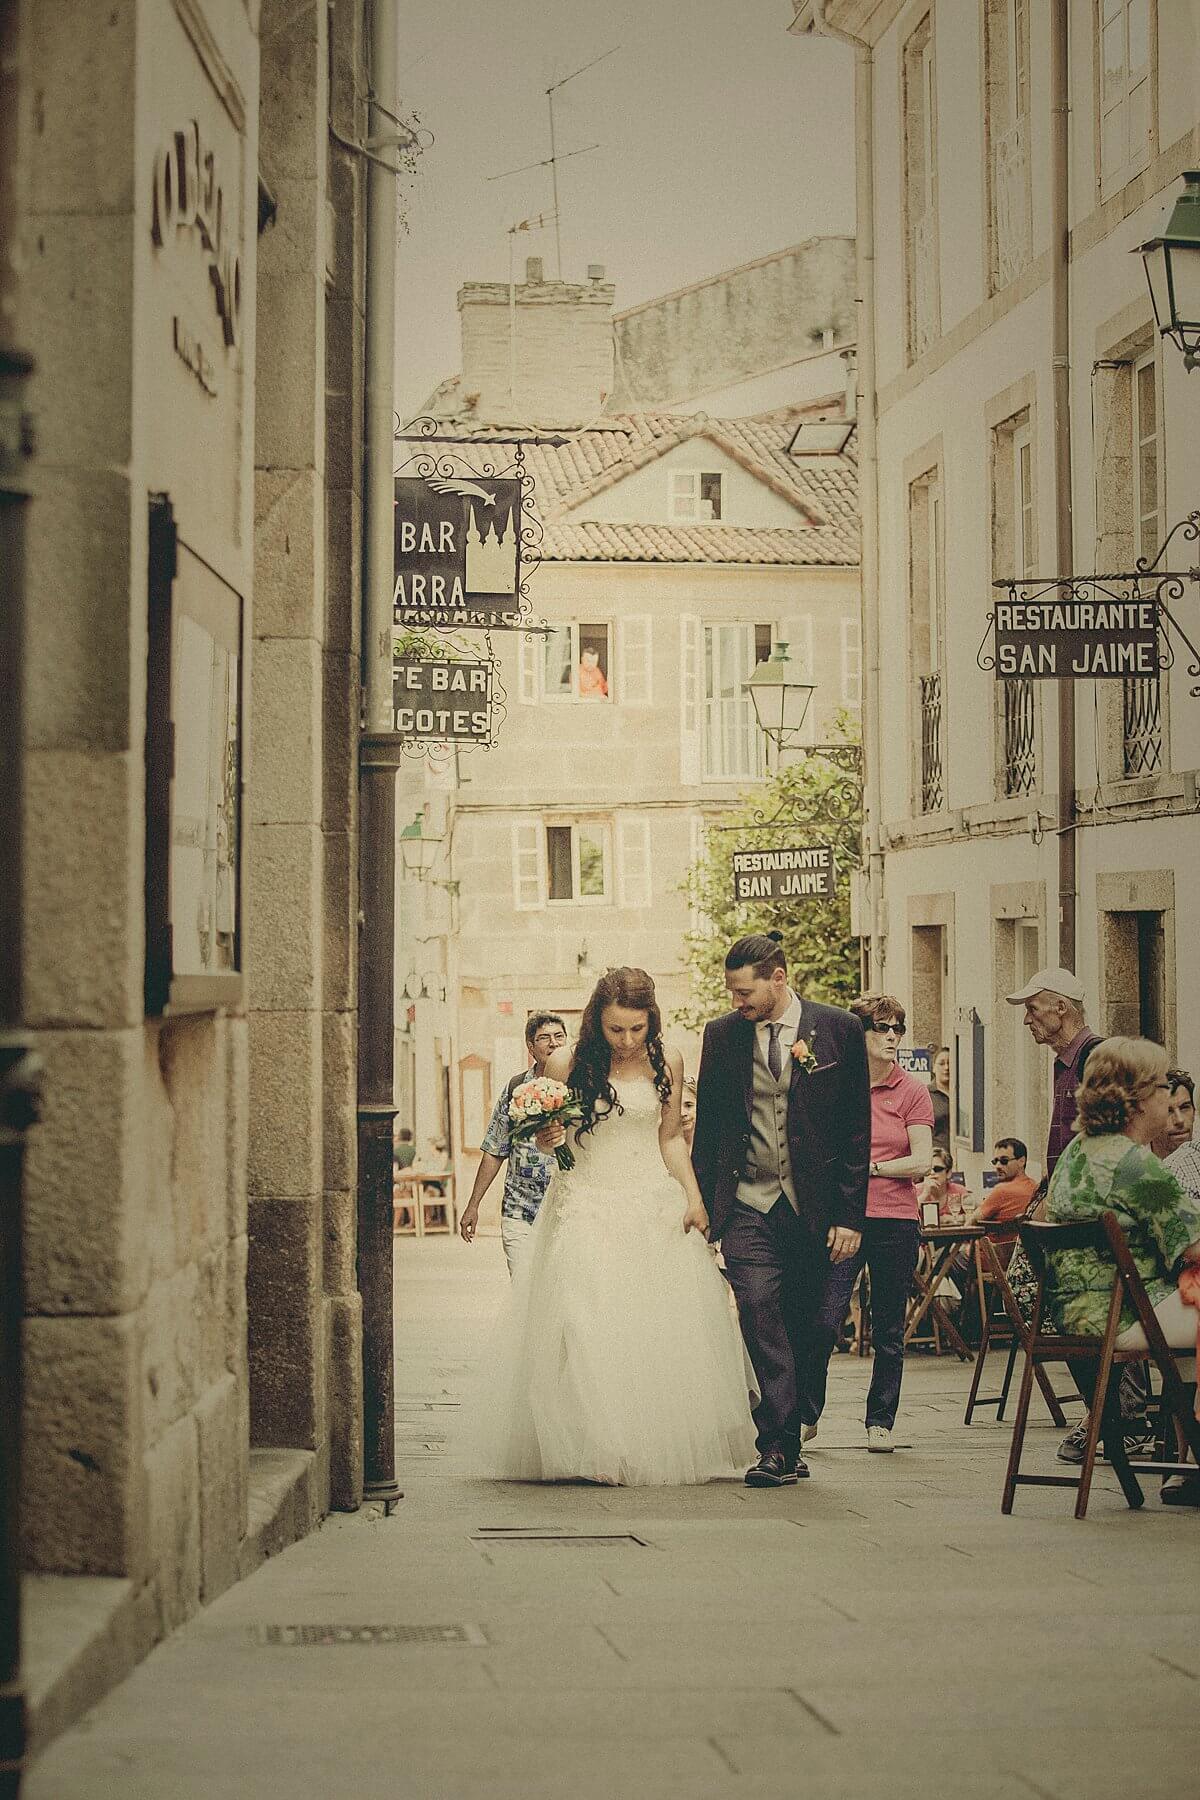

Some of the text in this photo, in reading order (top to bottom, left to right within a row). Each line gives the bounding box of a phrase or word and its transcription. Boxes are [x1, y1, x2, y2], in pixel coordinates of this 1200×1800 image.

[401, 521, 457, 553] BAR
[394, 574, 467, 607] ARRA
[997, 604, 1154, 631] RESTAURANTE
[1000, 642, 1154, 674] SAN JAIME
[432, 667, 486, 692] BAR
[734, 849, 830, 873] RESTAURANTE
[739, 872, 829, 898] SAN JAIME
[898, 1057, 929, 1072] PICAR
